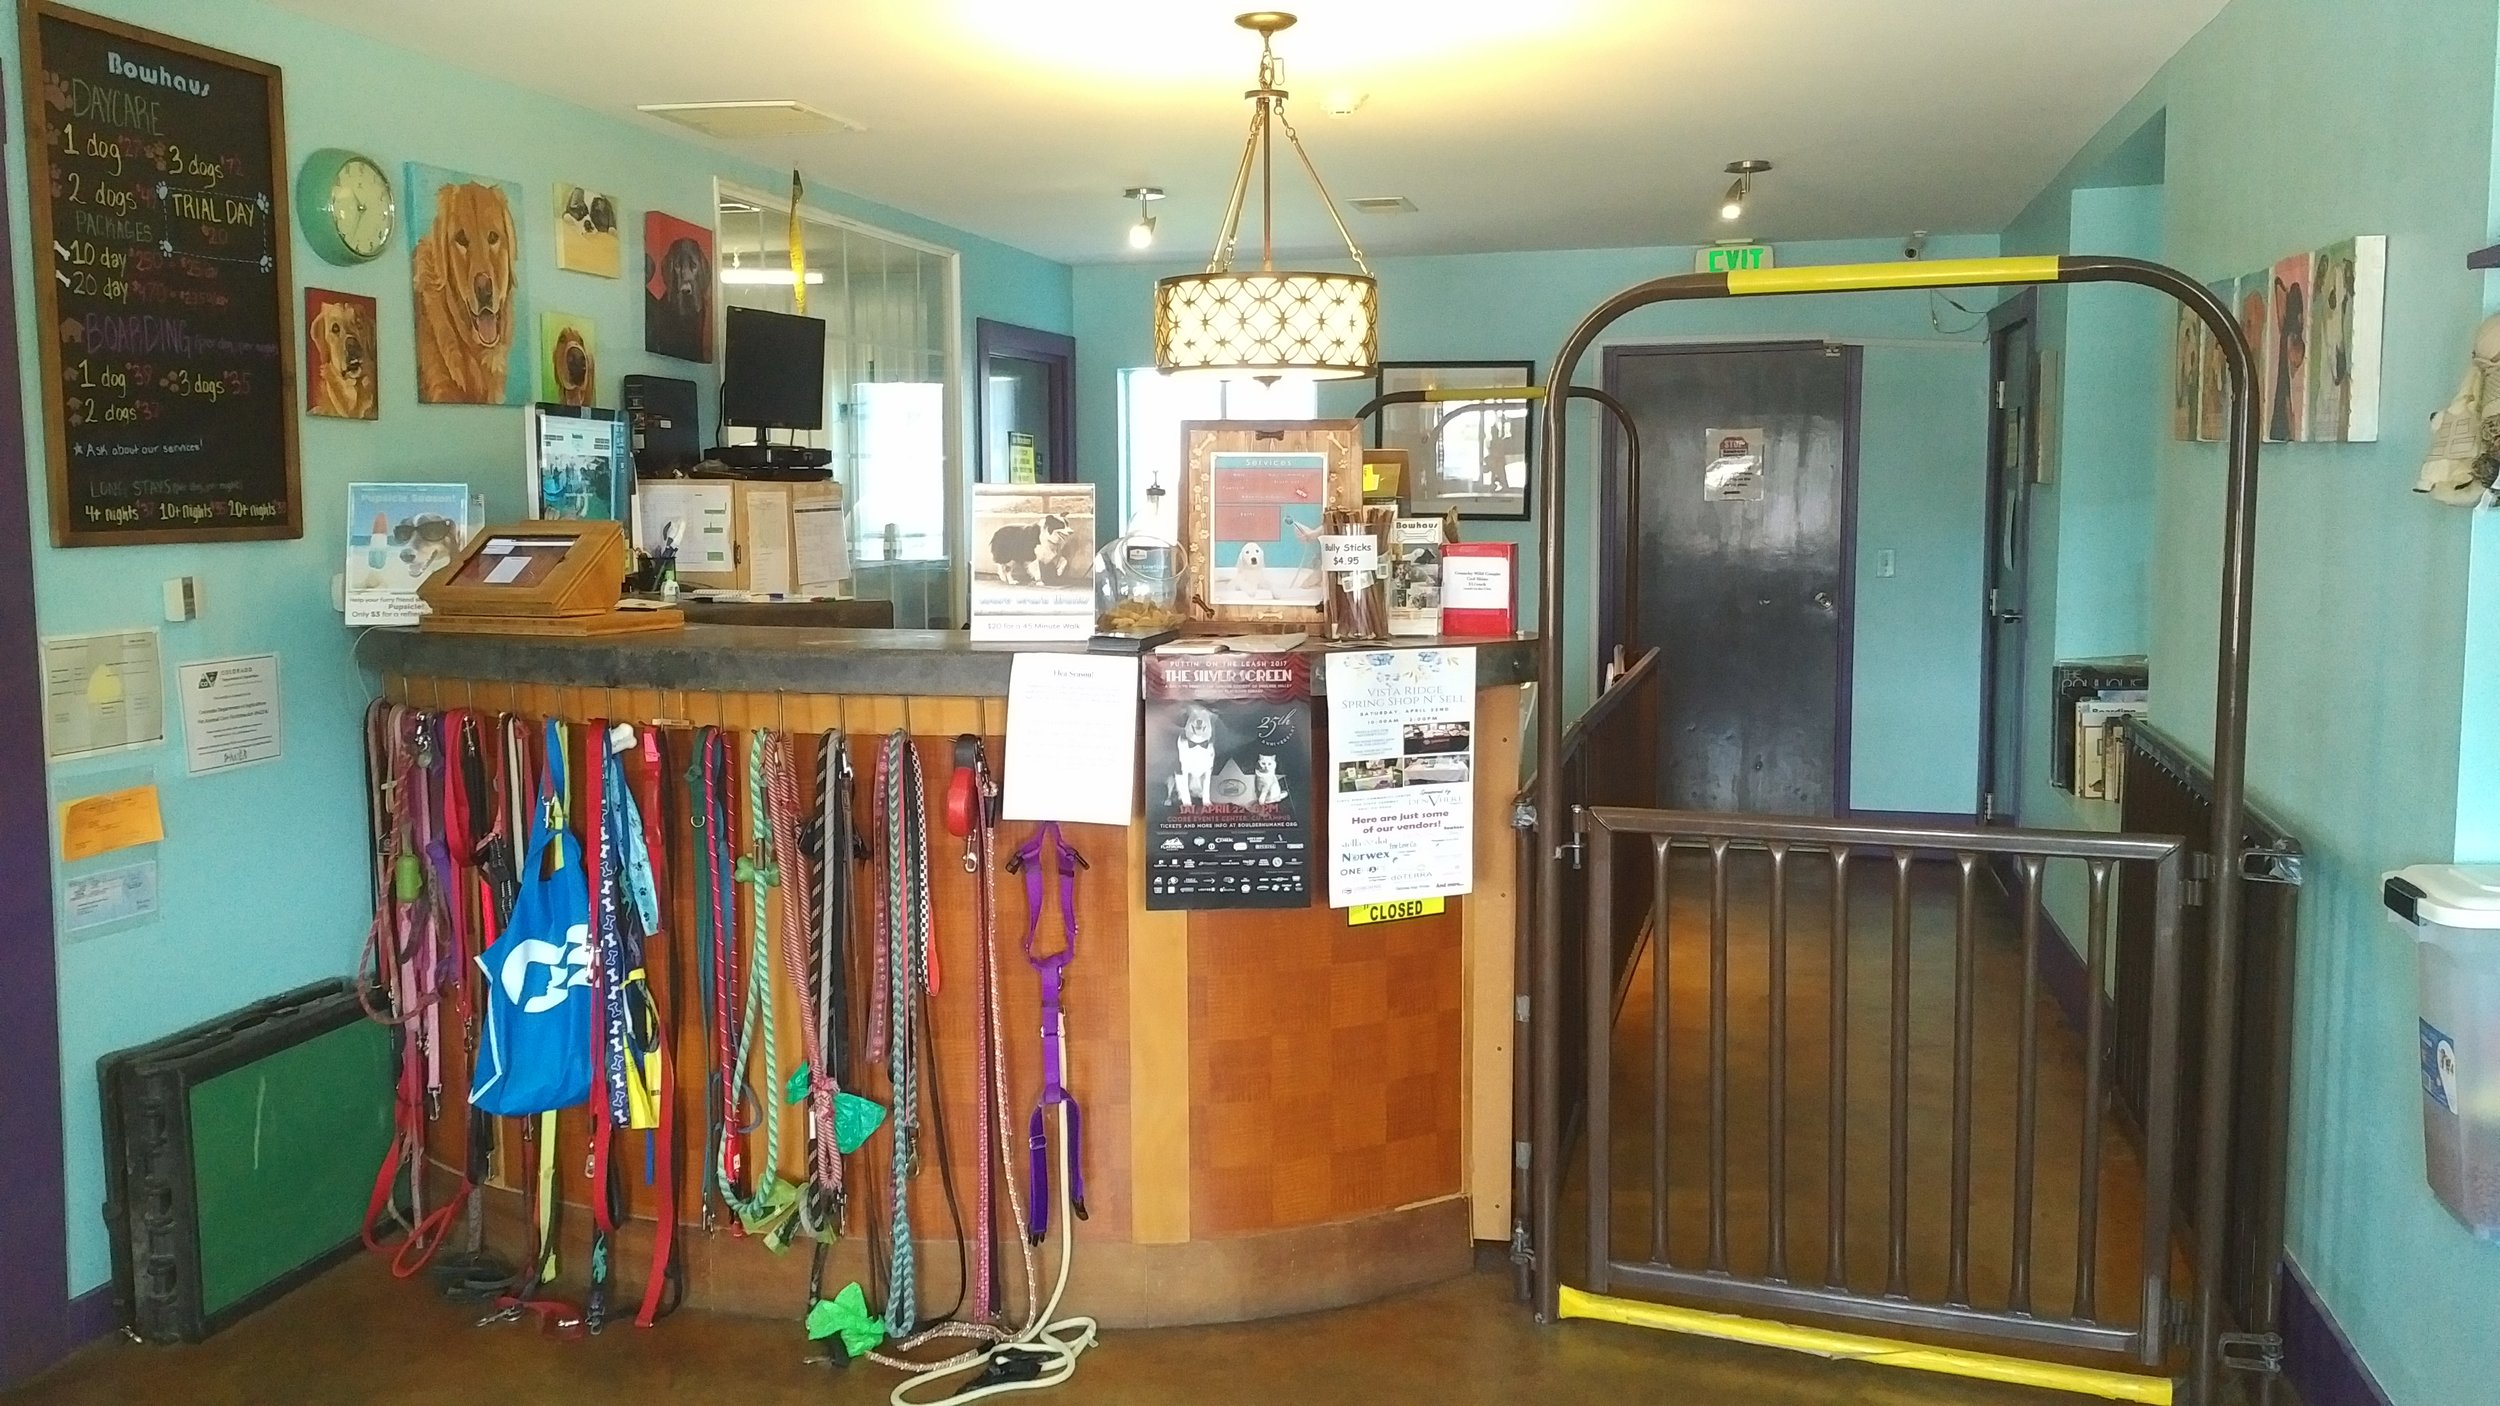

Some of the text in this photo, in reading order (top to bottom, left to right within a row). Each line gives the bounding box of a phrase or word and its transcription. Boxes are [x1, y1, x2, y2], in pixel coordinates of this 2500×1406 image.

[107, 51, 210, 98] Bowhaus
[72, 78, 165, 137] DAYCARE
[63, 123, 80, 155] 1
[86, 132, 122, 177] dog
[168, 145, 184, 175] 3
[188, 154, 225, 189] dogs
[68, 173, 86, 204] 2
[95, 181, 137, 217] dogs
[172, 193, 255, 227] TRIAL DAY
[76, 210, 153, 243] PACKAGES
[71, 240, 96, 266] 10
[100, 246, 127, 277] day
[73, 272, 98, 296] 20
[102, 278, 129, 305] day
[86, 311, 191, 358] BOARDING
[78, 359, 97, 388] 1
[101, 371, 126, 398] dog
[178, 369, 192, 397] 3
[194, 373, 226, 403] dogs
[84, 399, 98, 423] 2
[105, 402, 137, 425] dogs
[85, 443, 109, 458] Ask
[112, 443, 140, 457] about
[142, 444, 160, 454] our
[1245, 458, 1293, 467] Services
[132, 477, 172, 498] STAYS
[104, 504, 140, 526] nights
[181, 503, 214, 525] nights
[250, 502, 277, 522] nights
[1395, 521, 1439, 530] Bowhaus
[1343, 543, 1372, 552] Sticks
[1333, 556, 1360, 566] $4.95
[1165, 669, 1293, 682] THE SILVER SCREEN
[1342, 698, 1386, 710] SPRING
[1387, 695, 1420, 707] SHOP
[1439, 694, 1466, 703] SELL
[1367, 686, 1443, 697] VISTA RIDGE
[1201, 804, 1231, 814] APRIL
[1351, 816, 1378, 825] Here
[1400, 812, 1419, 822] just
[1422, 810, 1450, 819] some
[1362, 825, 1375, 834] of
[1397, 820, 1442, 830] vendors!
[1340, 867, 1361, 877] ONE
[1369, 900, 1424, 921] CLOSED
